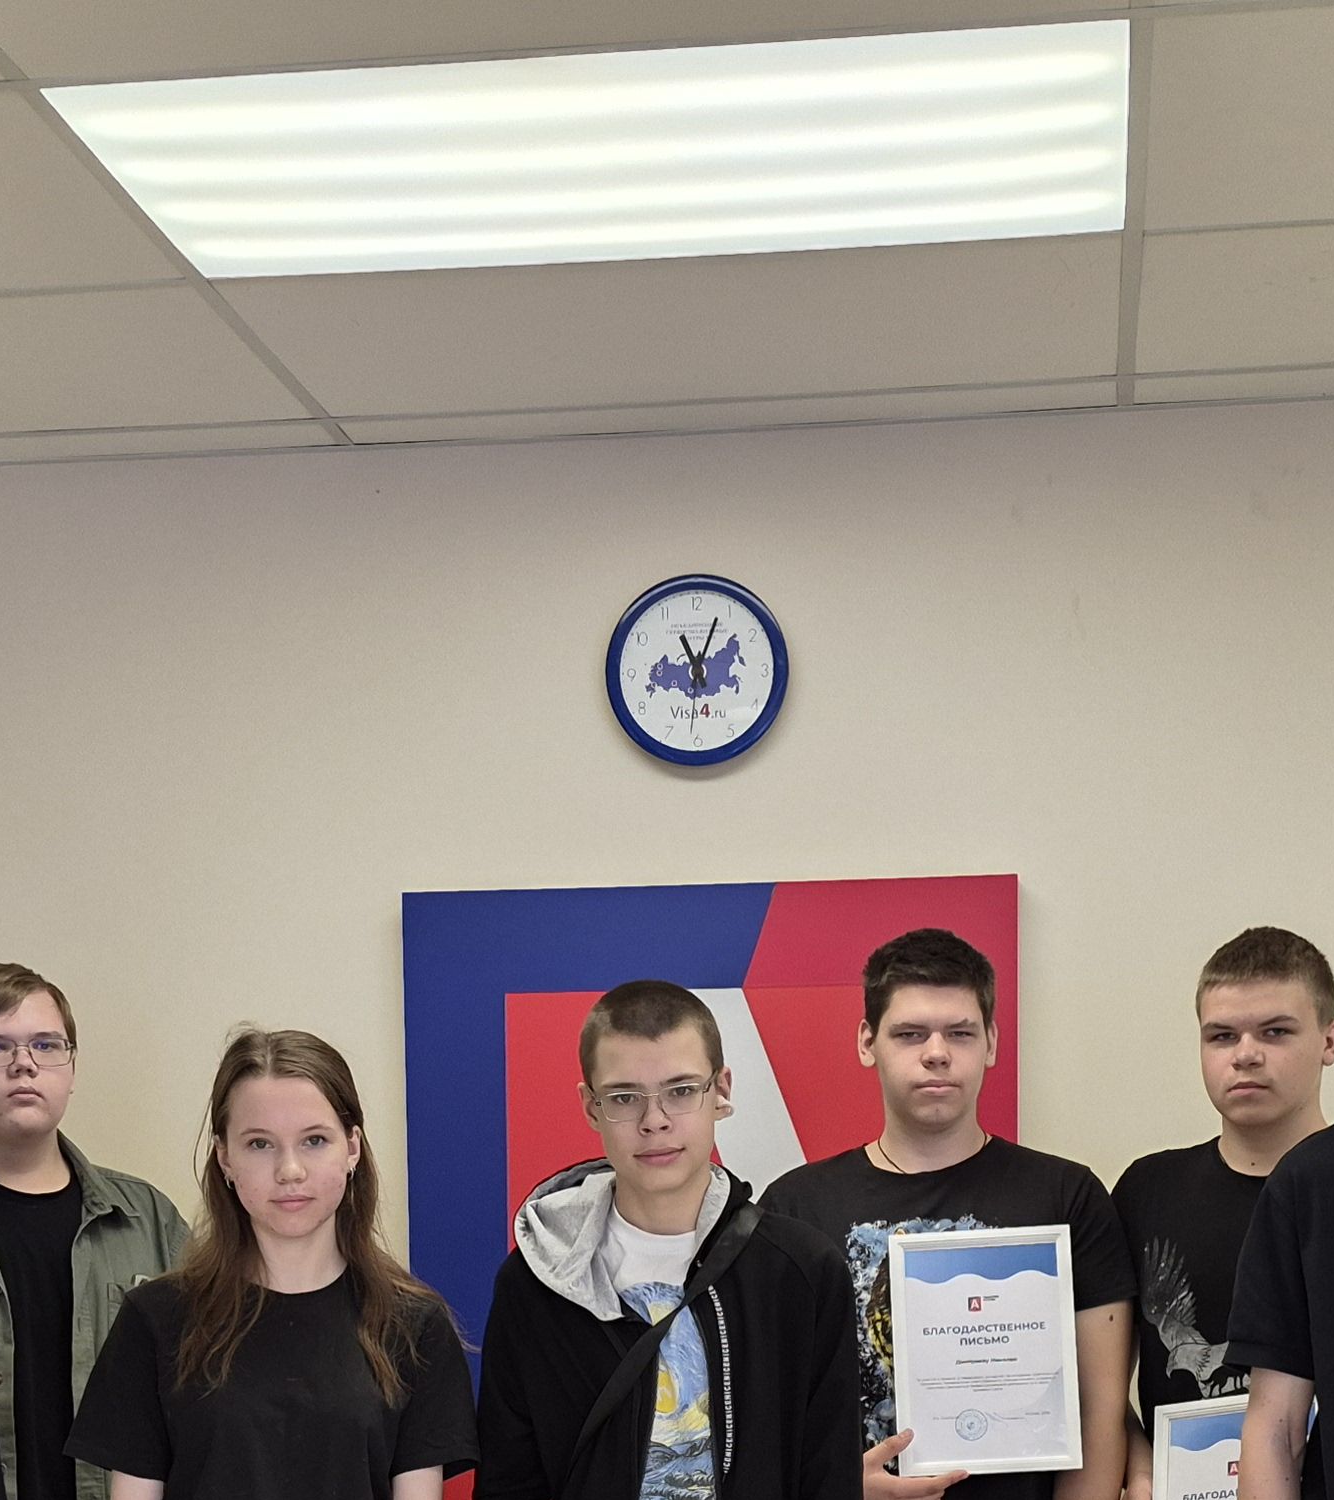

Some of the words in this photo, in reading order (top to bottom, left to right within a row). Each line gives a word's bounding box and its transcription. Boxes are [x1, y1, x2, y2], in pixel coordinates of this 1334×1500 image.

[691, 596, 703, 611] 12
[661, 607, 669, 620] 11
[636, 631, 649, 647] 10
[749, 628, 758, 643] 2
[627, 668, 637, 682] 9
[761, 664, 770, 678] 3
[638, 701, 647, 716] 8
[670, 703, 727, 719] Visa4.ru
[665, 725, 674, 740] 7
[726, 724, 735, 738] 5
[693, 734, 703, 748] 6
[922, 1321, 1046, 1336] БЛАГОДАРСТВЕННОЕ
[960, 1335, 1010, 1346] ПИСЬМО
